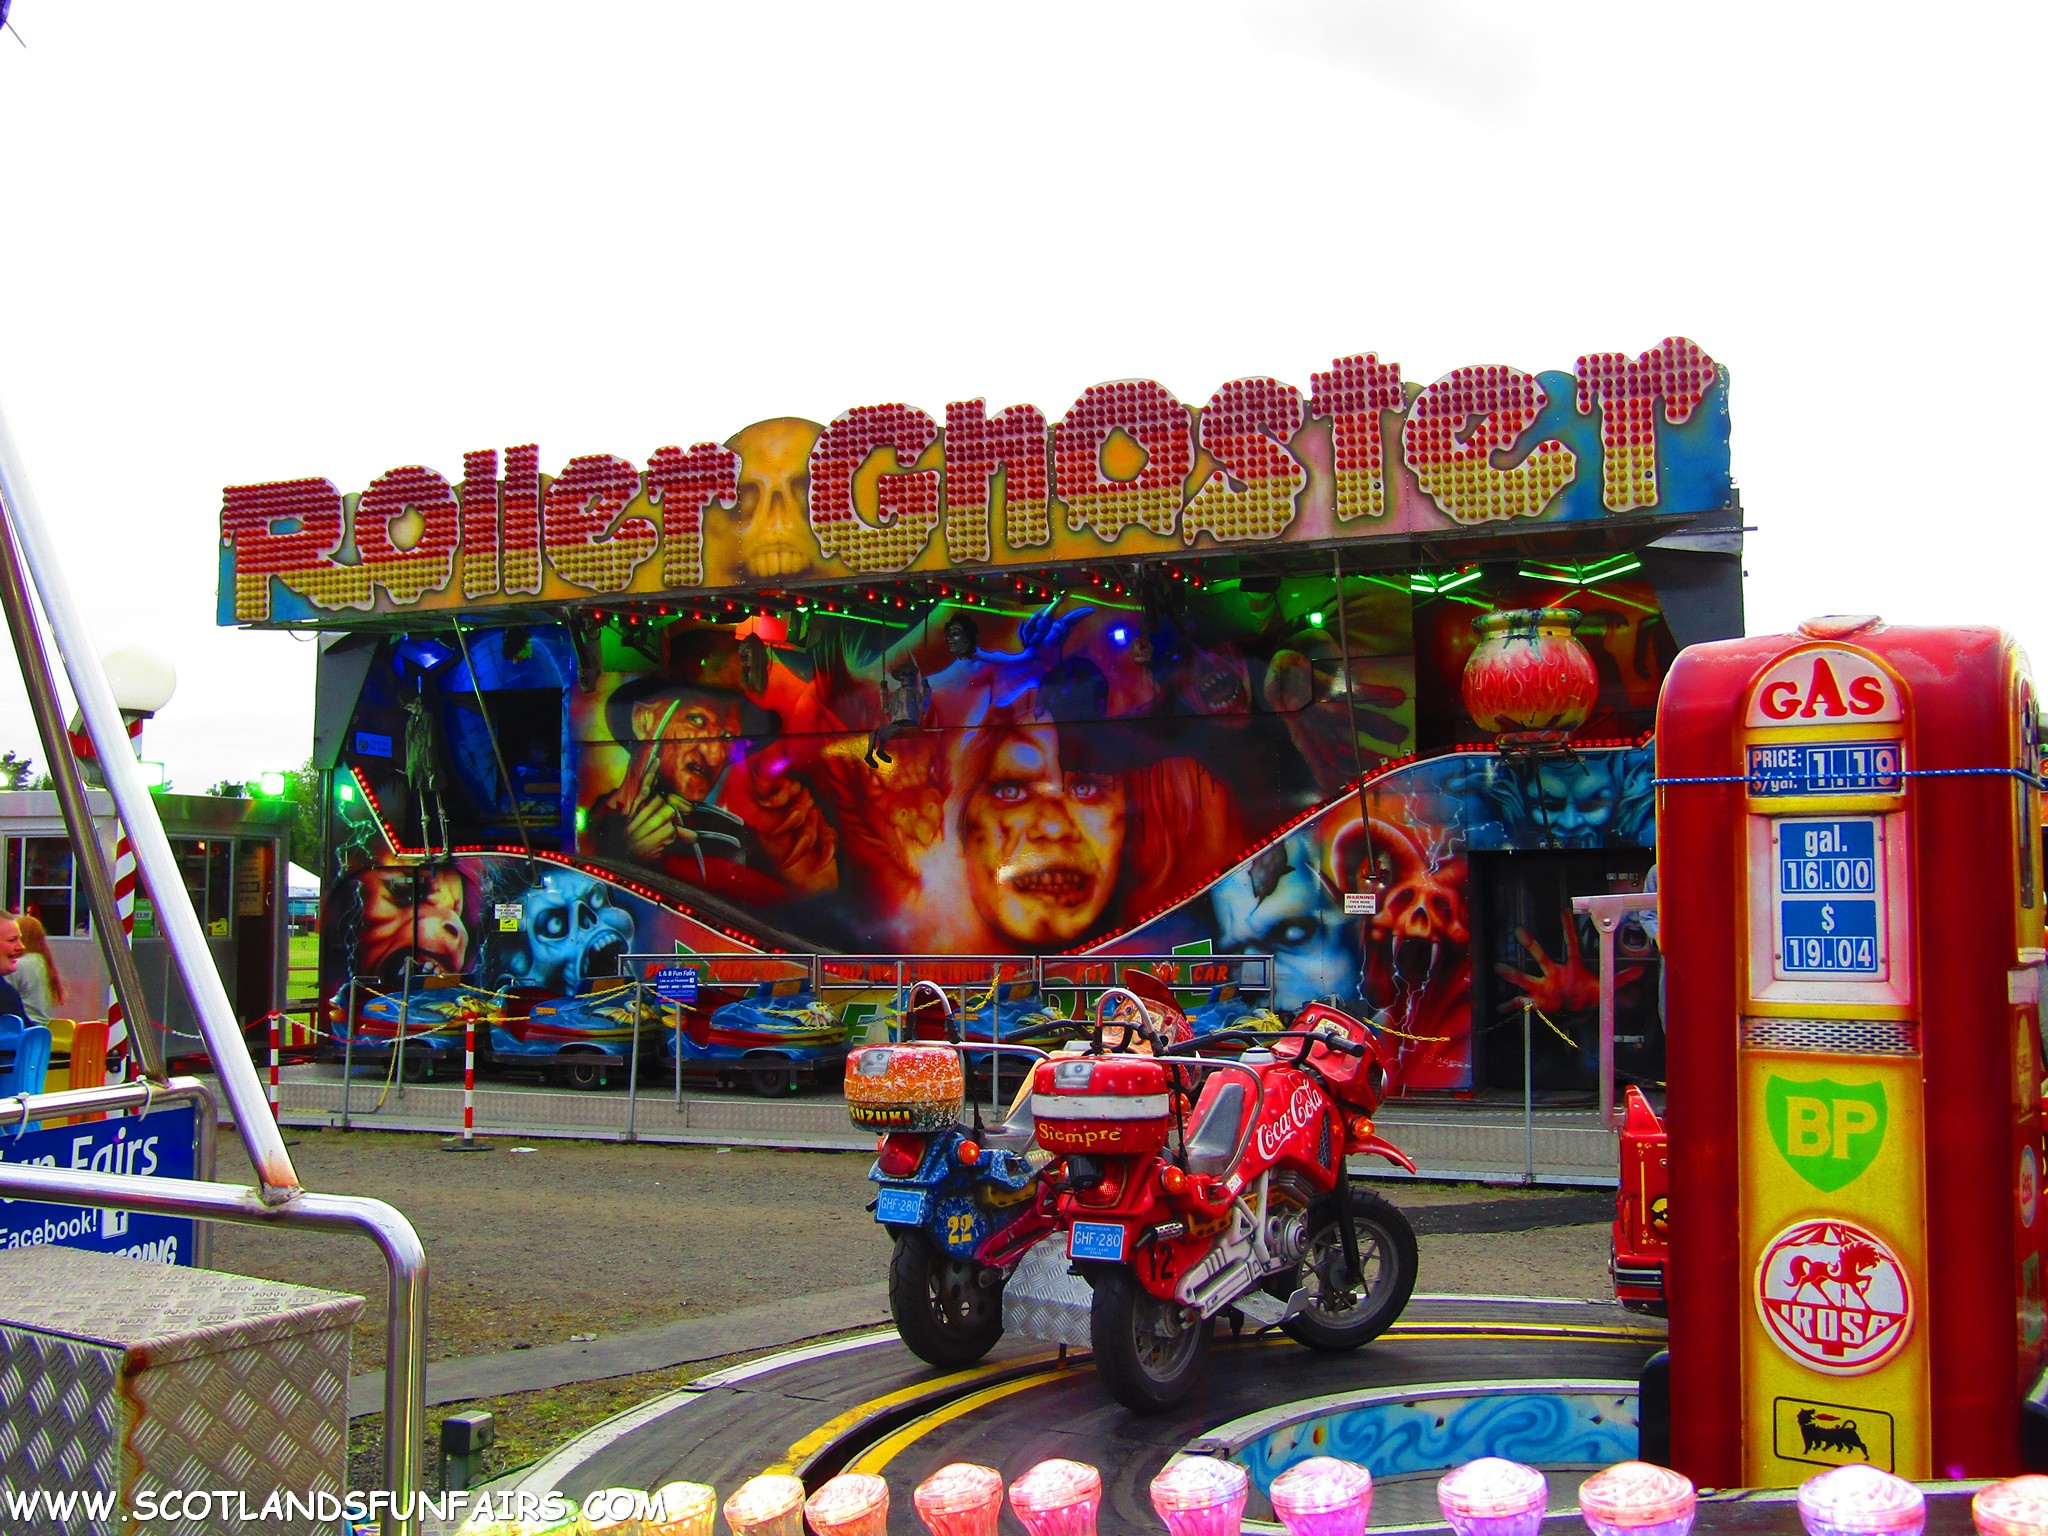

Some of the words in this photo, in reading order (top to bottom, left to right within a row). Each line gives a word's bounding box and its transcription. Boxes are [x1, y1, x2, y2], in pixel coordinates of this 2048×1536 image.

[222, 441, 742, 623] Roller
[808, 336, 1715, 573] Ghoster
[1760, 658, 1885, 720] GAS
[1752, 749, 1802, 769] PRICE:
[1804, 824, 1848, 858] gal.
[1785, 862, 1872, 889] 16.00
[1821, 903, 1835, 934] $
[1789, 939, 1871, 968] 19.04
[1193, 965, 1229, 982] CAR
[850, 1106, 911, 1126] SUZUKI
[1785, 1096, 1878, 1160] BP
[1039, 1123, 1121, 1147] Siempre
[947, 1214, 973, 1244] 22
[1149, 1244, 1173, 1282] 12
